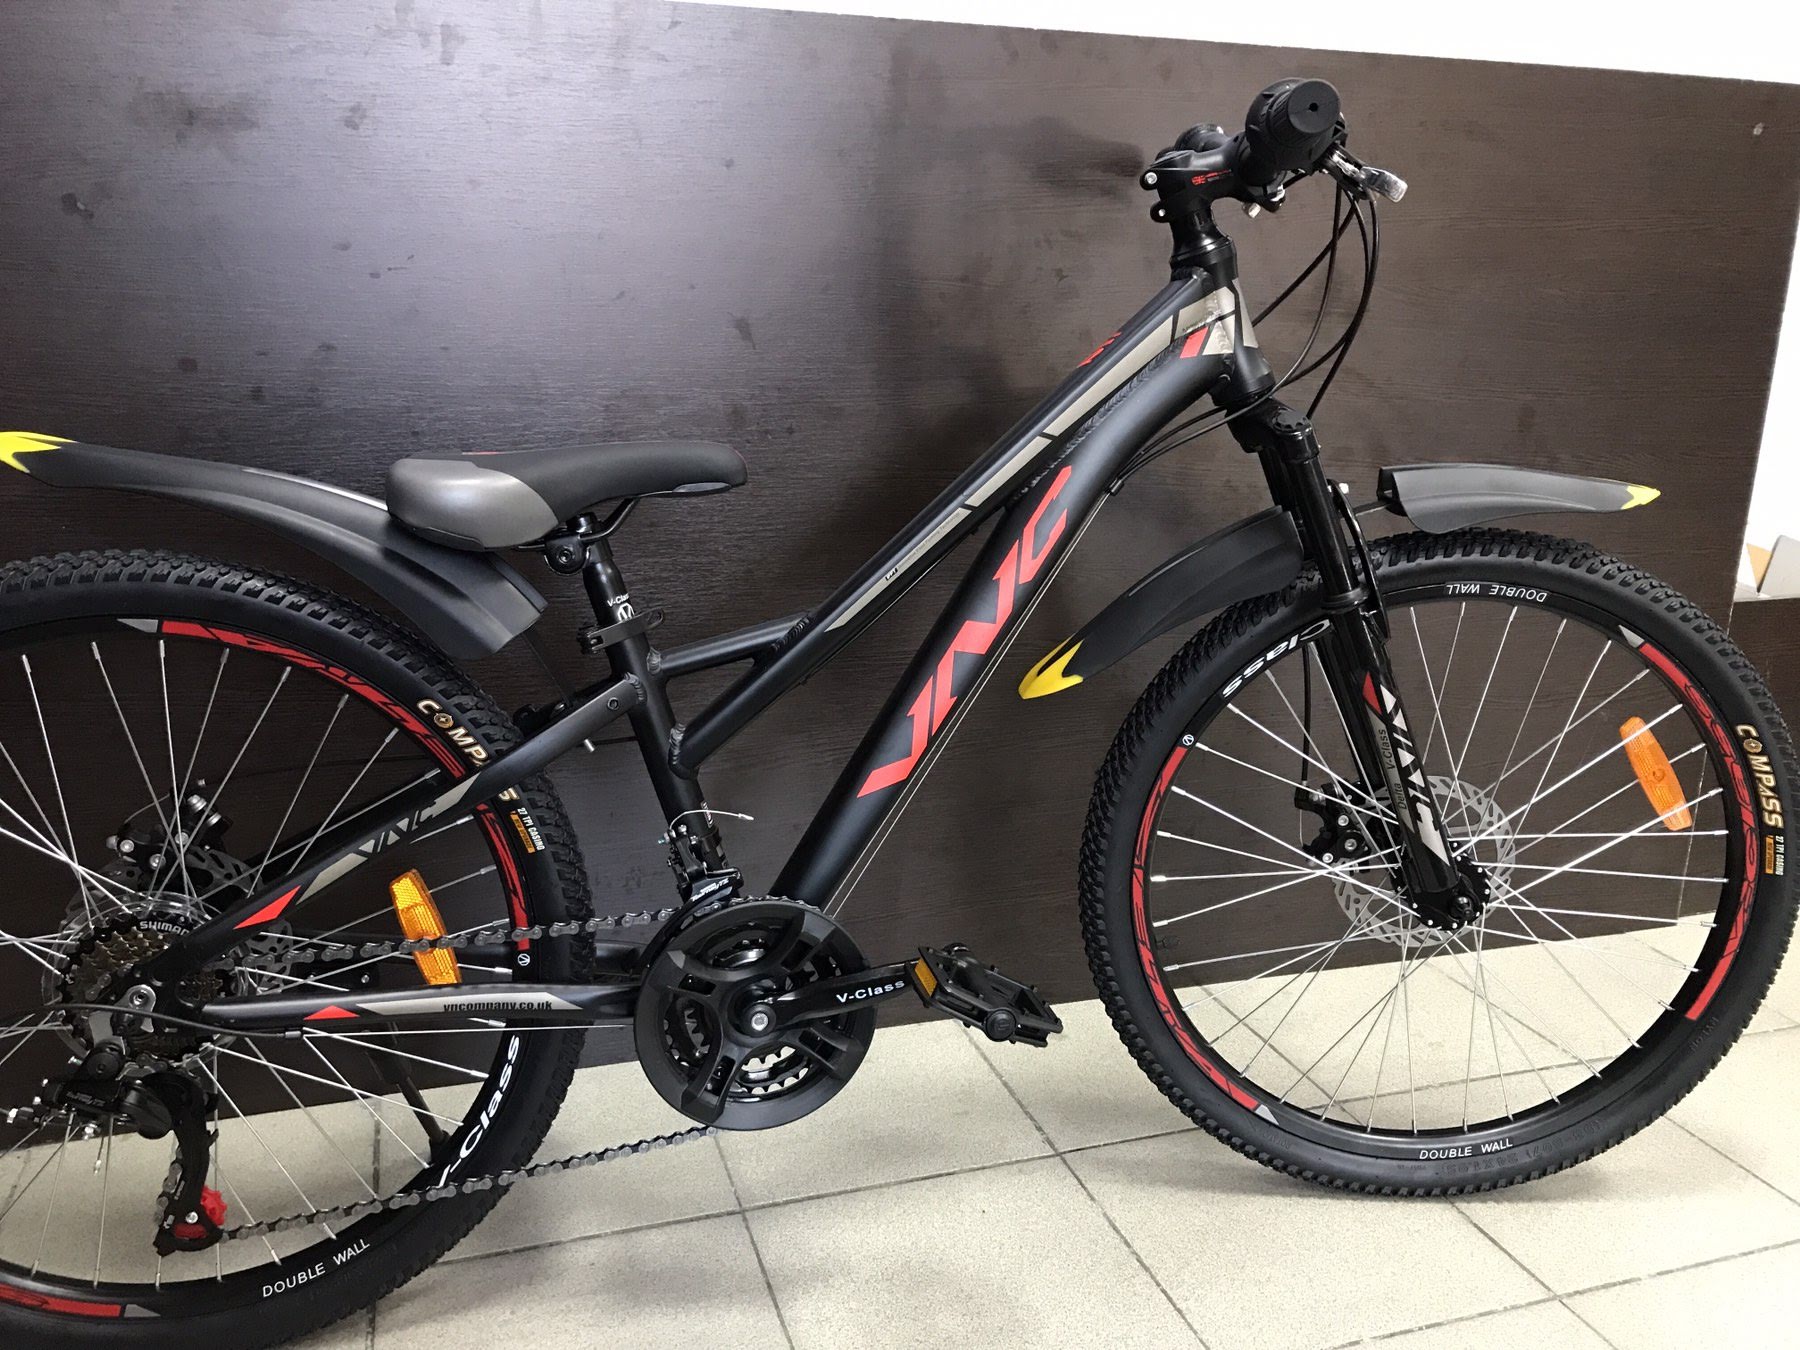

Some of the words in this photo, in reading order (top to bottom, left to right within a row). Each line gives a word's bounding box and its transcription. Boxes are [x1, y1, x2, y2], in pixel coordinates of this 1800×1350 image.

[1446, 583, 1481, 595] WALL
[1489, 584, 1547, 603] DOUBLE
[1222, 619, 1333, 699] Class
[1378, 728, 1396, 771] V-Class
[1735, 722, 1785, 830] COMPASS
[139, 920, 191, 937] SHIMAN
[836, 980, 905, 1003] V-Class
[443, 1000, 553, 1013] vncompany.co.uk
[1419, 1146, 1473, 1160] DOUBLE
[1481, 1138, 1514, 1154] WALL
[262, 1262, 326, 1298] DOUBLE
[332, 1239, 371, 1265] WALL
